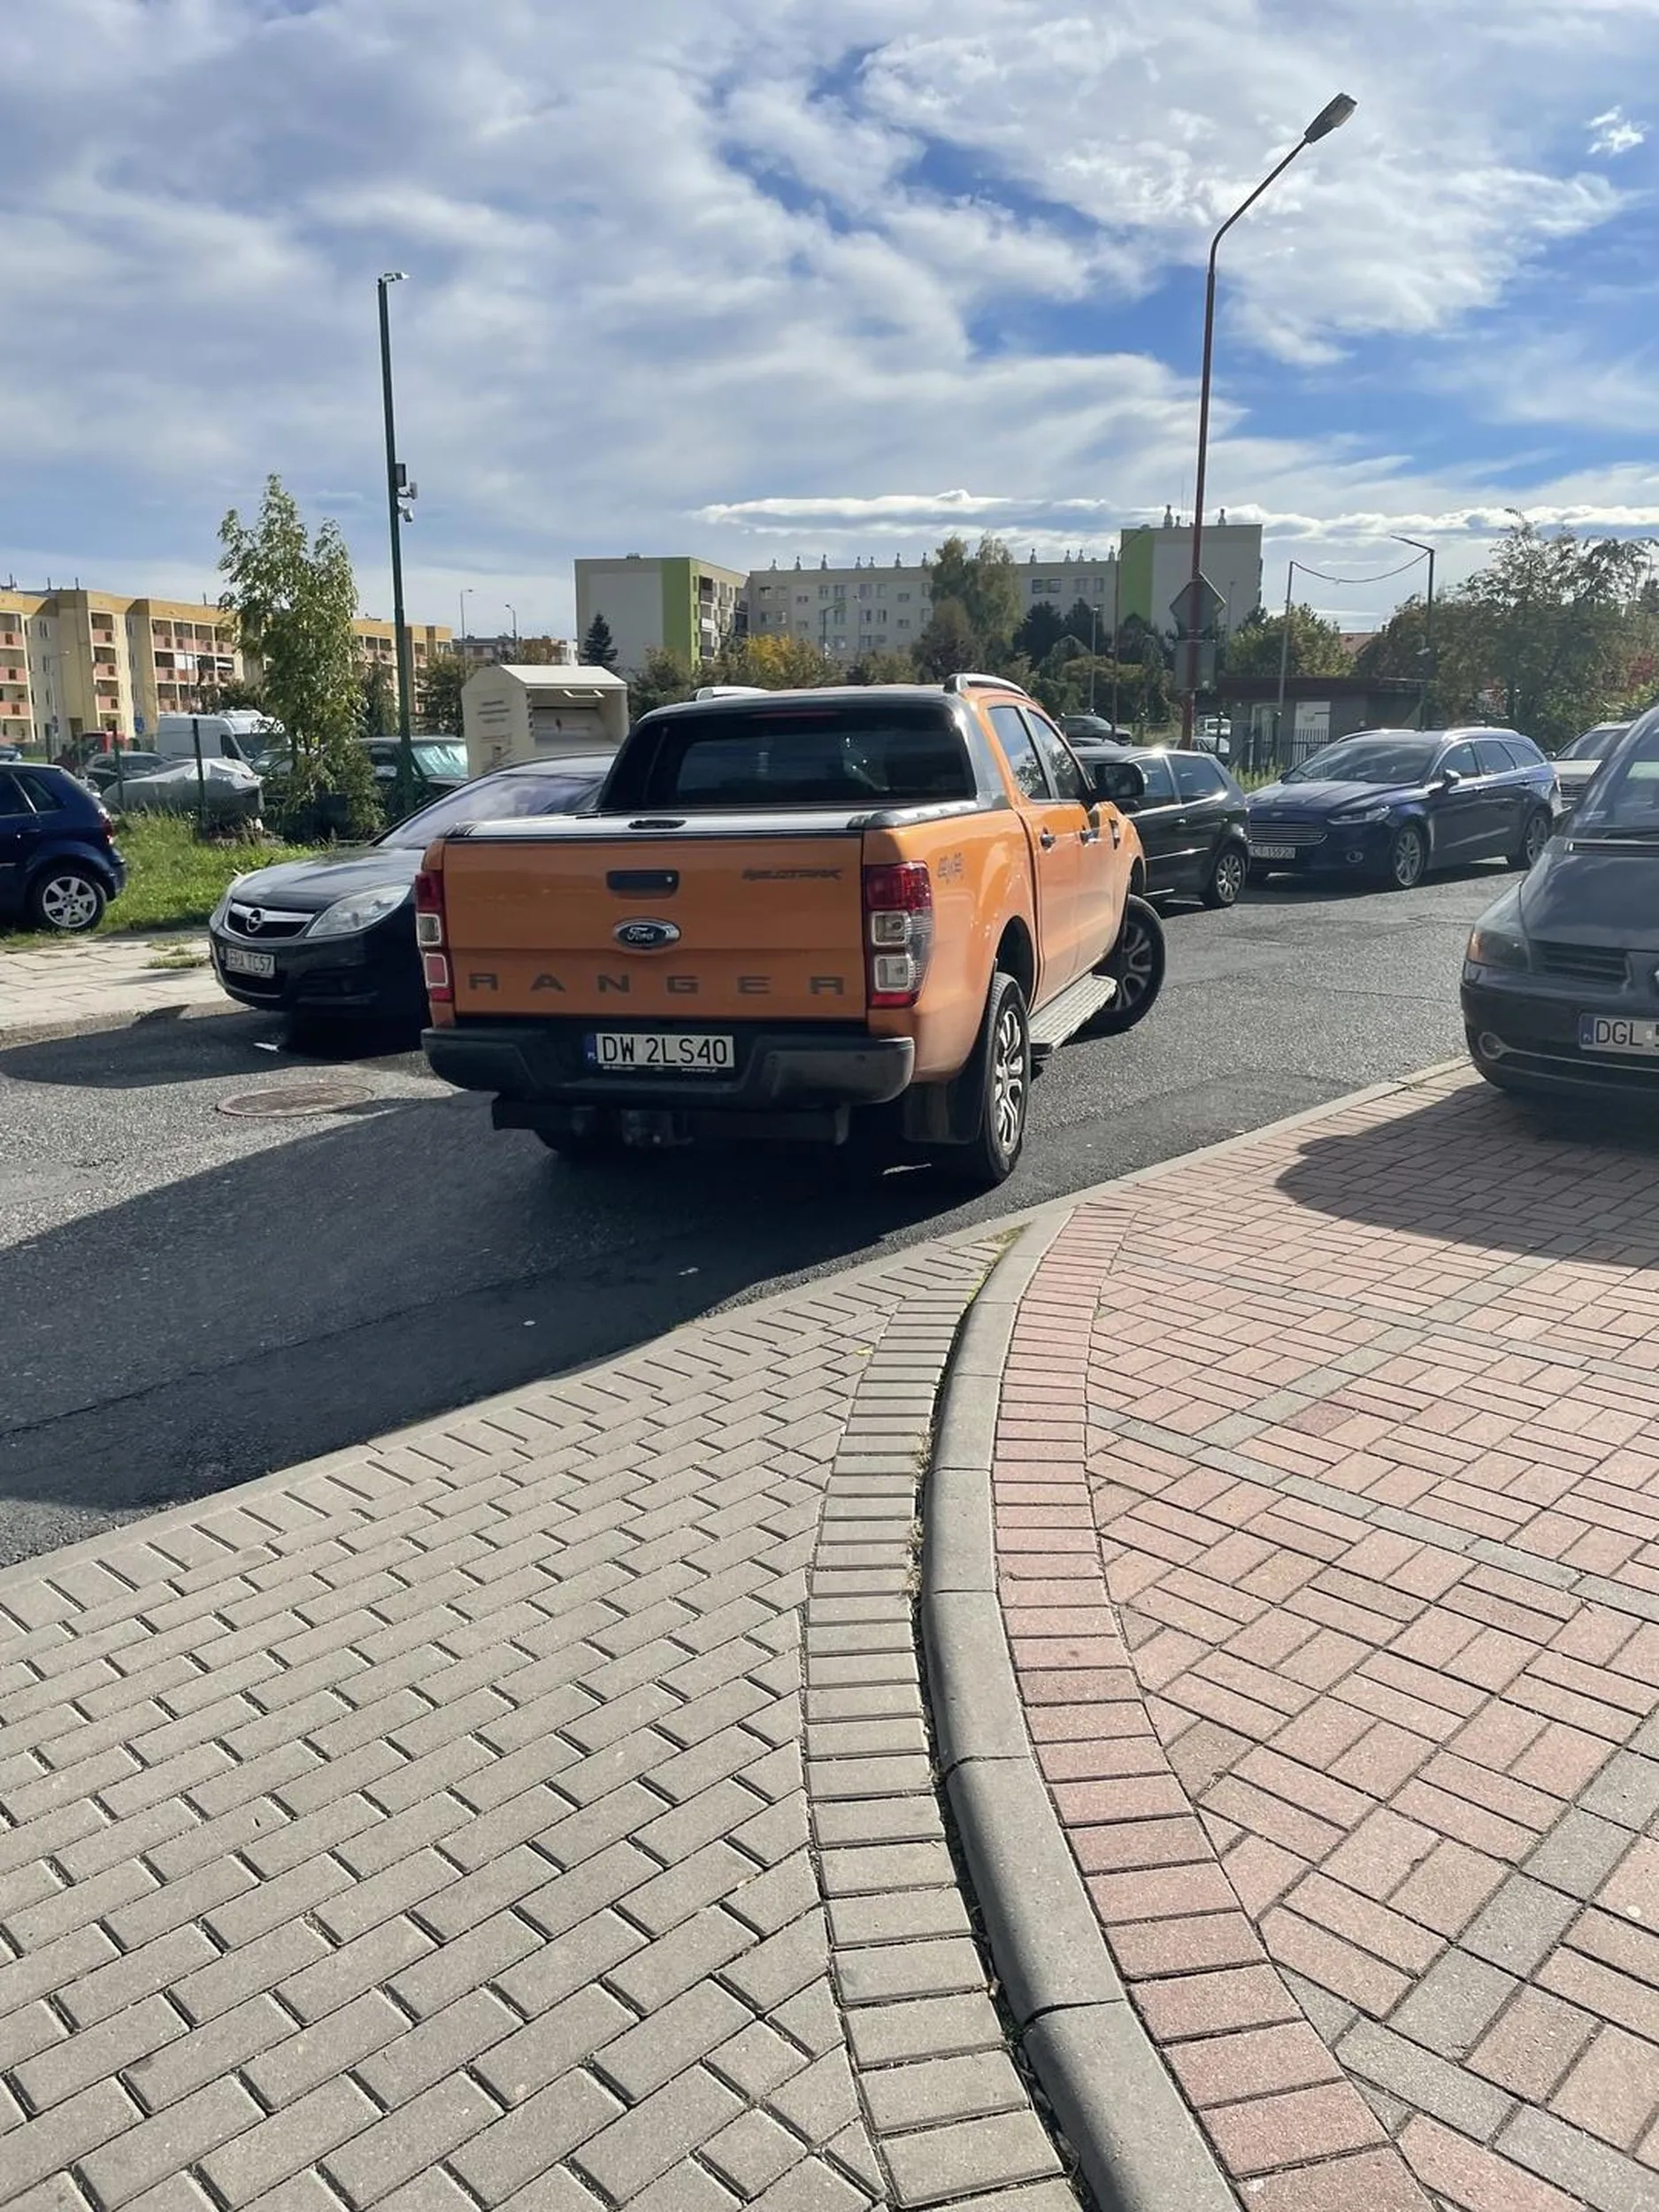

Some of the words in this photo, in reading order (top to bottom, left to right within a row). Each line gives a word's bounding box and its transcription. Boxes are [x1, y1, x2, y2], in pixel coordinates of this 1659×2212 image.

[468, 972, 845, 995] RANGER
[1595, 1019, 1643, 1047] DGL
[602, 1036, 634, 1062] DW
[645, 1037, 727, 1064] 2LS40
